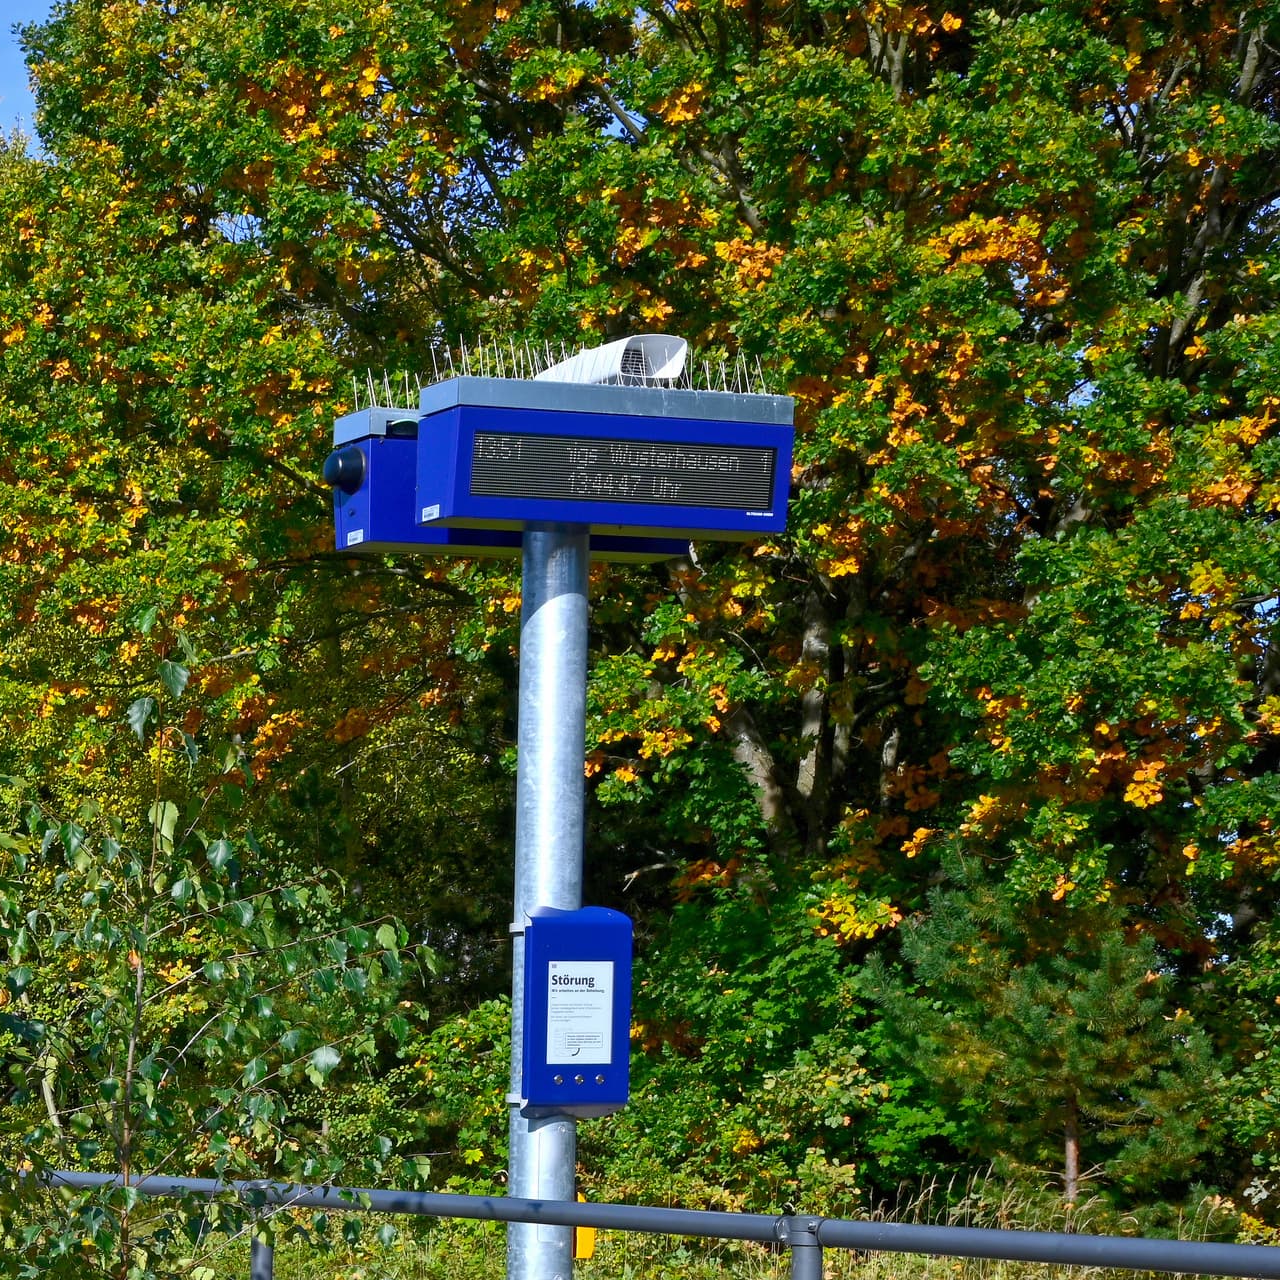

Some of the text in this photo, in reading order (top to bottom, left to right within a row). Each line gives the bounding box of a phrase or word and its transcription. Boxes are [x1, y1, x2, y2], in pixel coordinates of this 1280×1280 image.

[475, 436, 522, 460] 13:51
[610, 444, 740, 472] Wusterhausen
[567, 472, 683, 499] 13:44:47 Uhr
[551, 974, 595, 988] Störung
